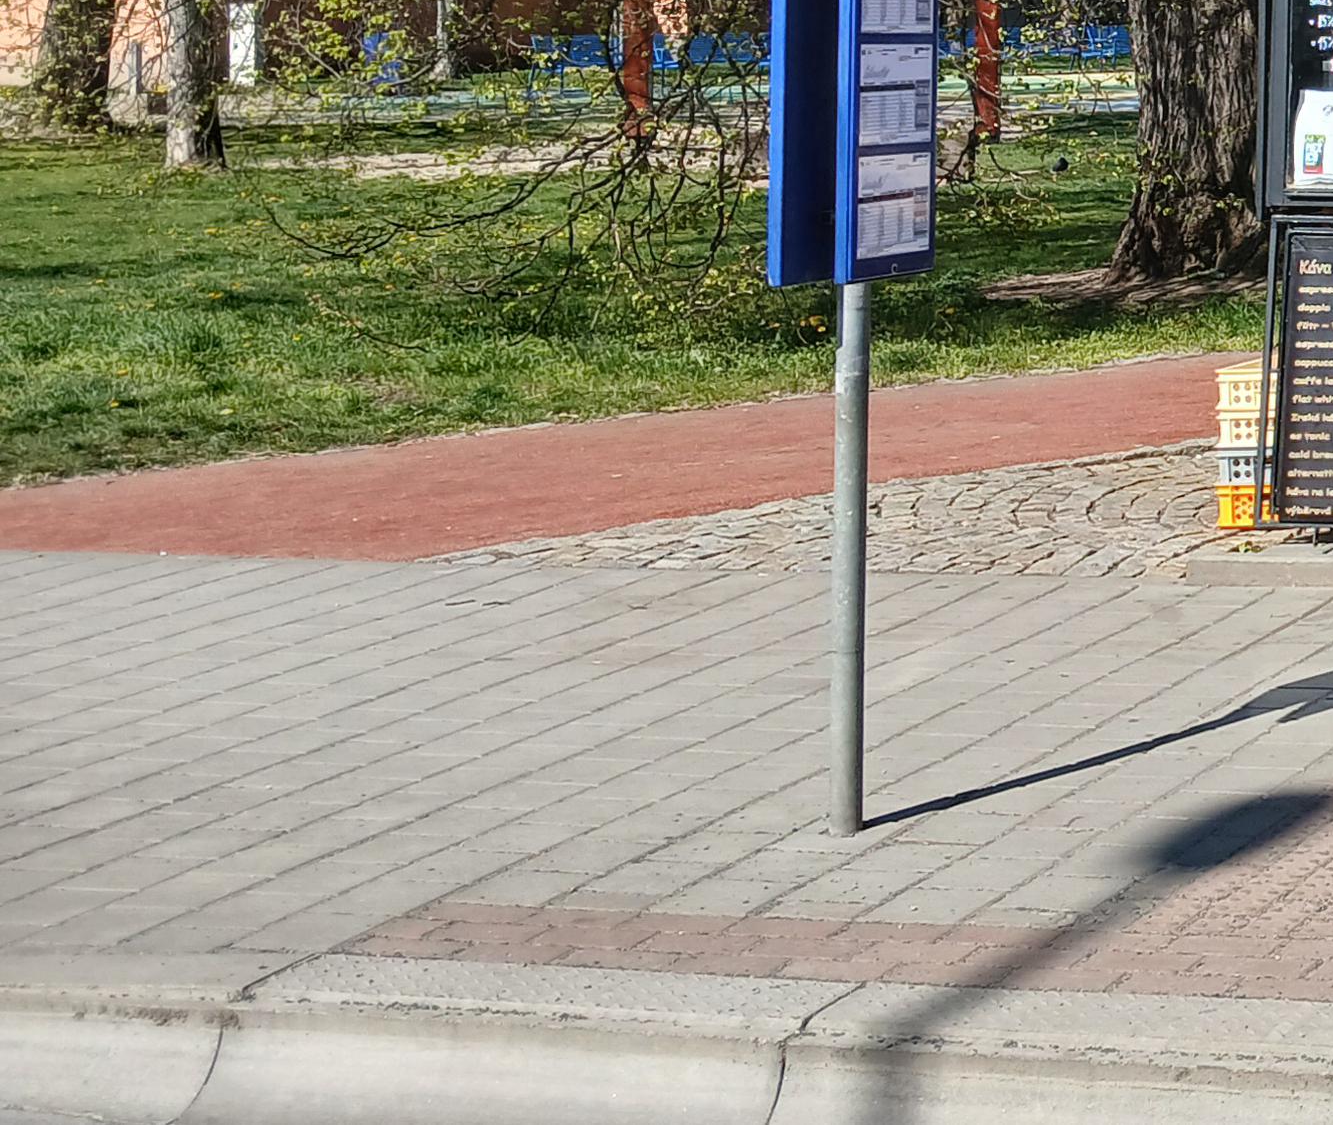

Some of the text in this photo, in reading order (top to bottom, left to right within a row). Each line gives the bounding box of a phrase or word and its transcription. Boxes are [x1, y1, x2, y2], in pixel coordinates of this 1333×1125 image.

[1299, 259, 1332, 275] Káva
[1297, 303, 1331, 314] doppio
[1292, 395, 1312, 404] flat
[1305, 432, 1330, 441] tonic
[1288, 450, 1310, 459] cold
[1285, 487, 1310, 496] káva
[1312, 488, 1324, 496] na
